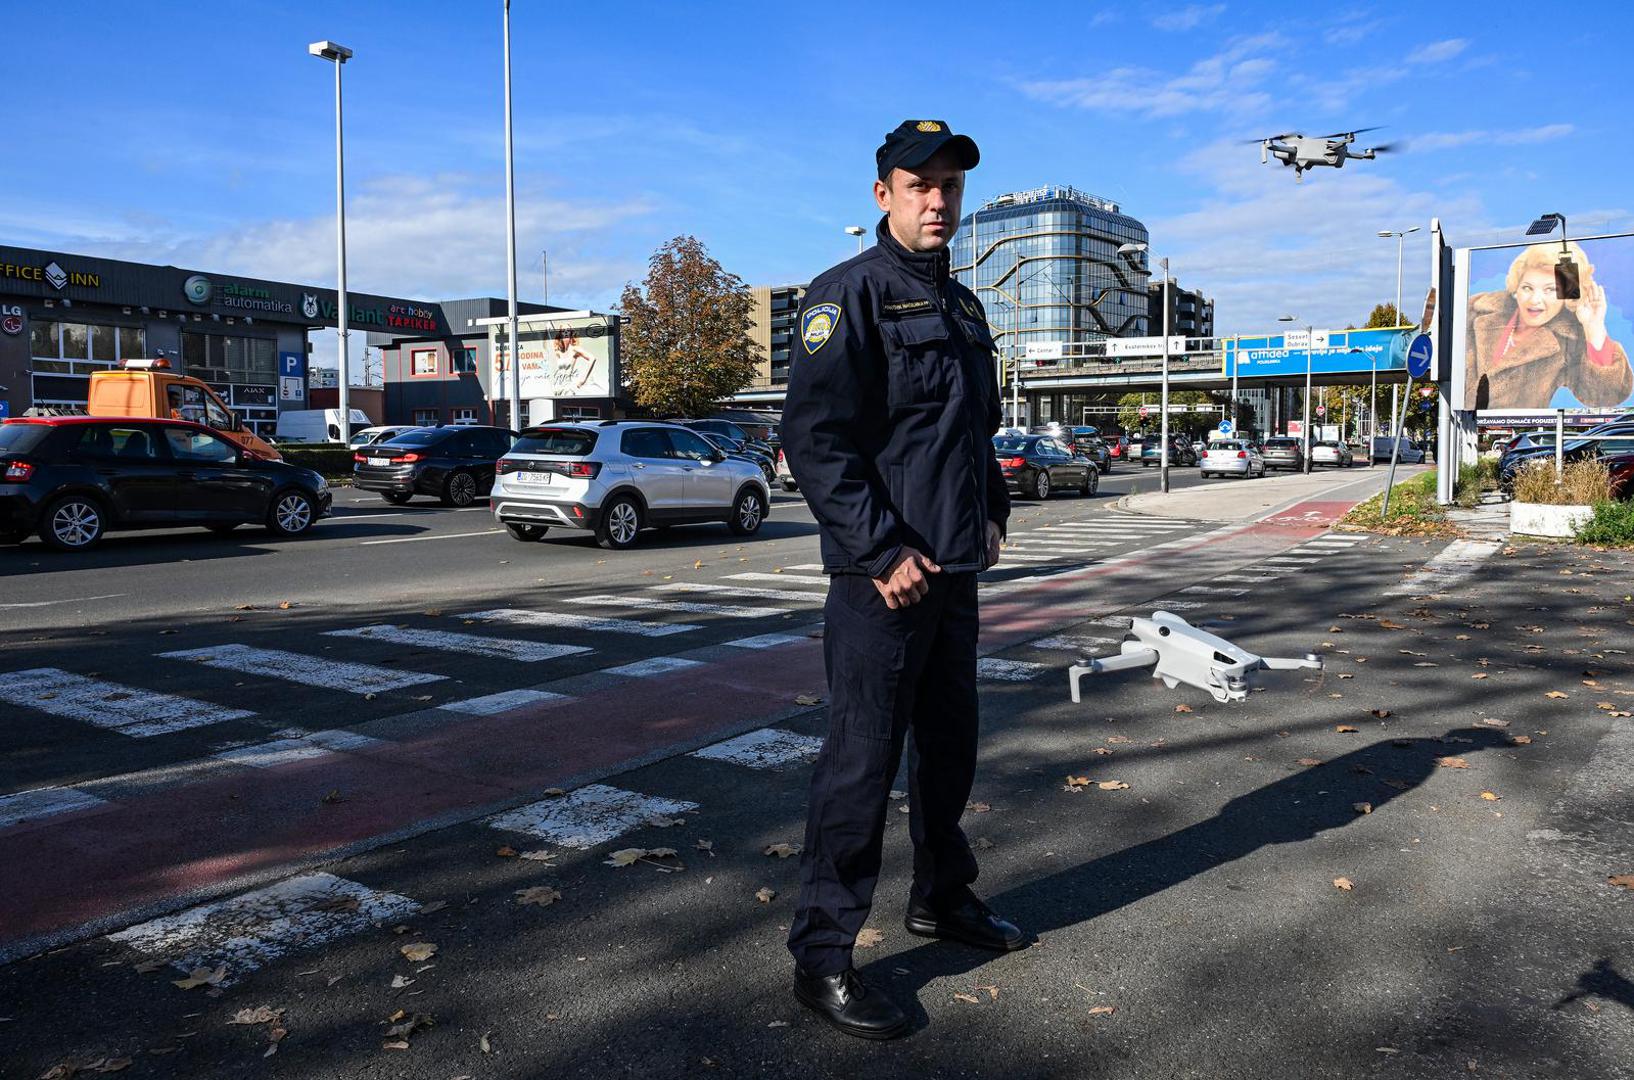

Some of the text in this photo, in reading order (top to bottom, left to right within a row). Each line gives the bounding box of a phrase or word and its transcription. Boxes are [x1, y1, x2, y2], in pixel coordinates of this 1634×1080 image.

[70, 271, 99, 287] INN
[224, 284, 270, 297] alarm
[2, 304, 21, 316] LG
[224, 296, 293, 313] automatika
[321, 301, 383, 324] Vallant
[408, 305, 433, 320] hobby
[387, 316, 438, 331] TAPIKER
[286, 356, 297, 373] P
